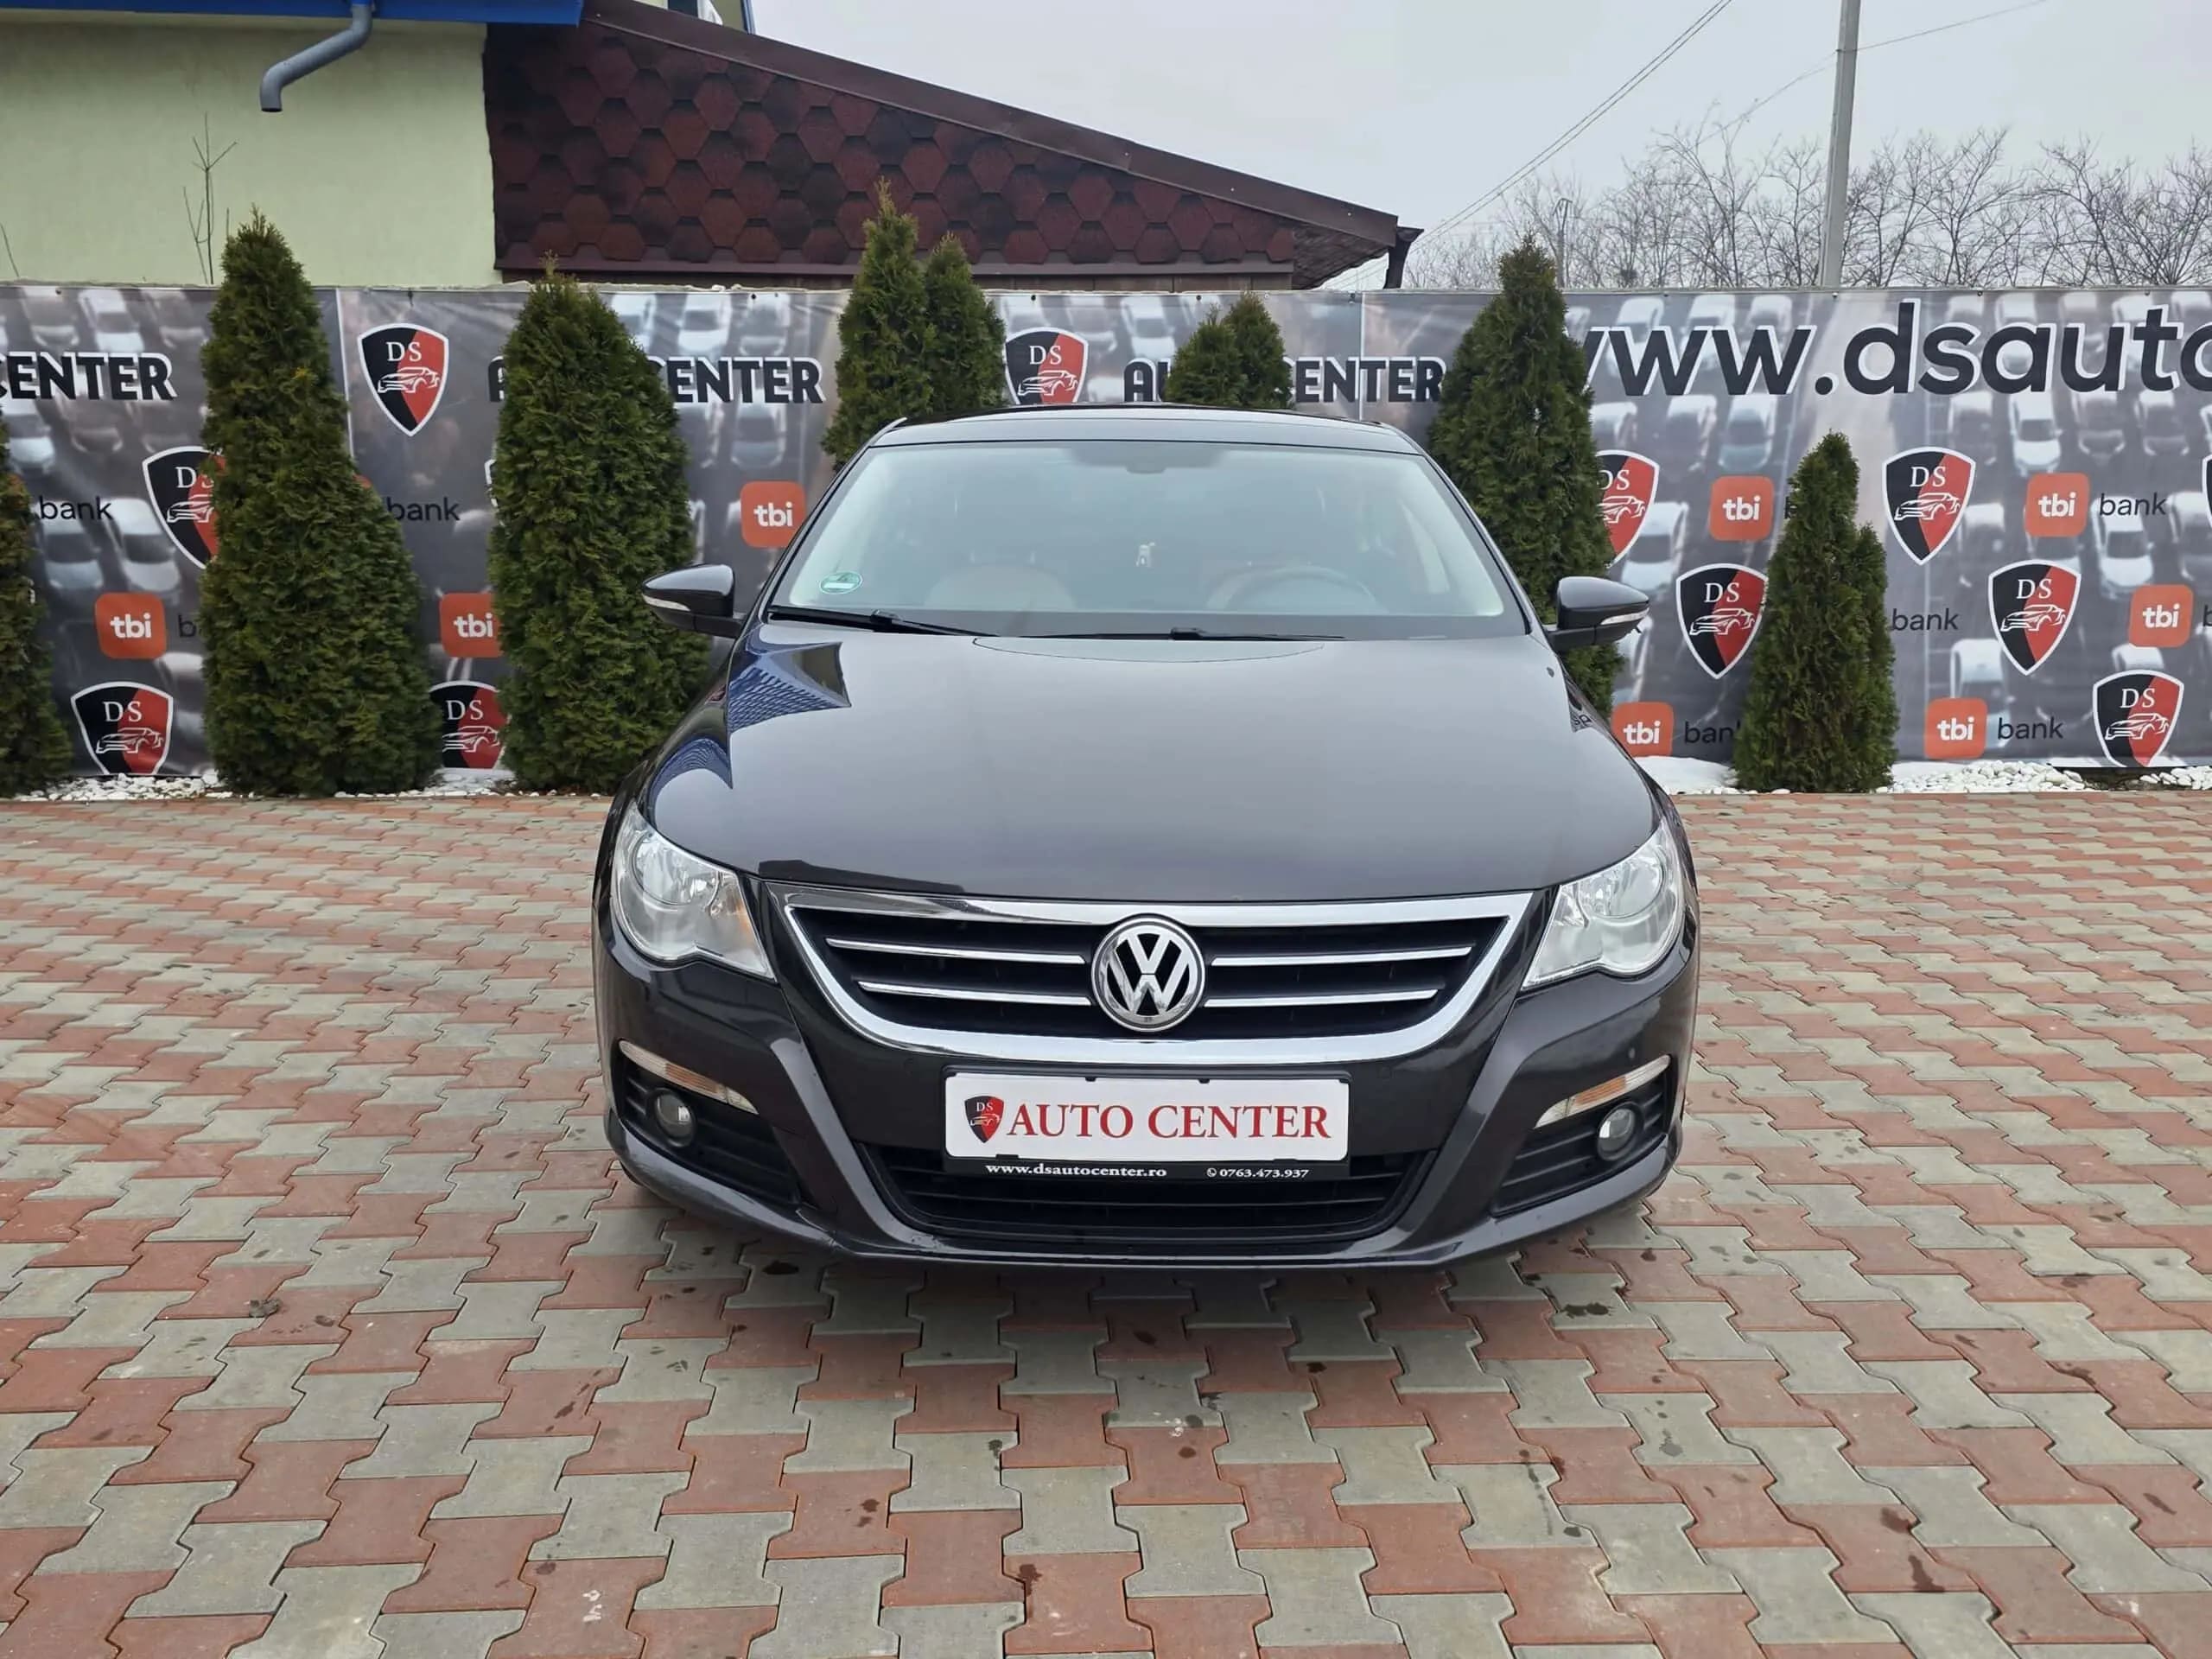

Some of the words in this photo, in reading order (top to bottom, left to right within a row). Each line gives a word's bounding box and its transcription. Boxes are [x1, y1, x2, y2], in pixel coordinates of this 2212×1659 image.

[385, 341, 423, 362] DS
[1028, 345, 1063, 365] DS
[646, 356, 826, 404] ENTER
[1282, 356, 1446, 404] ENTER
[1909, 465, 1947, 487] DS
[39, 495, 112, 520] bank
[385, 496, 461, 522] bank
[753, 501, 793, 527] tbi
[1722, 494, 1761, 521] tbi
[2037, 492, 2077, 518] tbi
[2100, 493, 2167, 517] bank
[1703, 582, 1740, 603] DS
[2016, 578, 2052, 600] DS
[110, 612, 152, 639] tbi
[453, 612, 493, 639] tbi
[1891, 607, 1960, 632] bank
[2142, 603, 2181, 629] tbi
[446, 699, 484, 721] DS
[2120, 688, 2156, 709] DS
[102, 701, 143, 723] DS
[1622, 721, 1662, 745] tbi
[1936, 716, 1974, 741] tbi
[1997, 716, 2064, 740] bank
[976, 1101, 995, 1112] DS
[1007, 1103, 1134, 1139] AUTO
[1147, 1104, 1332, 1139] CENTER
[985, 1162, 1167, 1178] www.dsautocenter.ro
[1219, 1167, 1310, 1179] 0763.473.937
